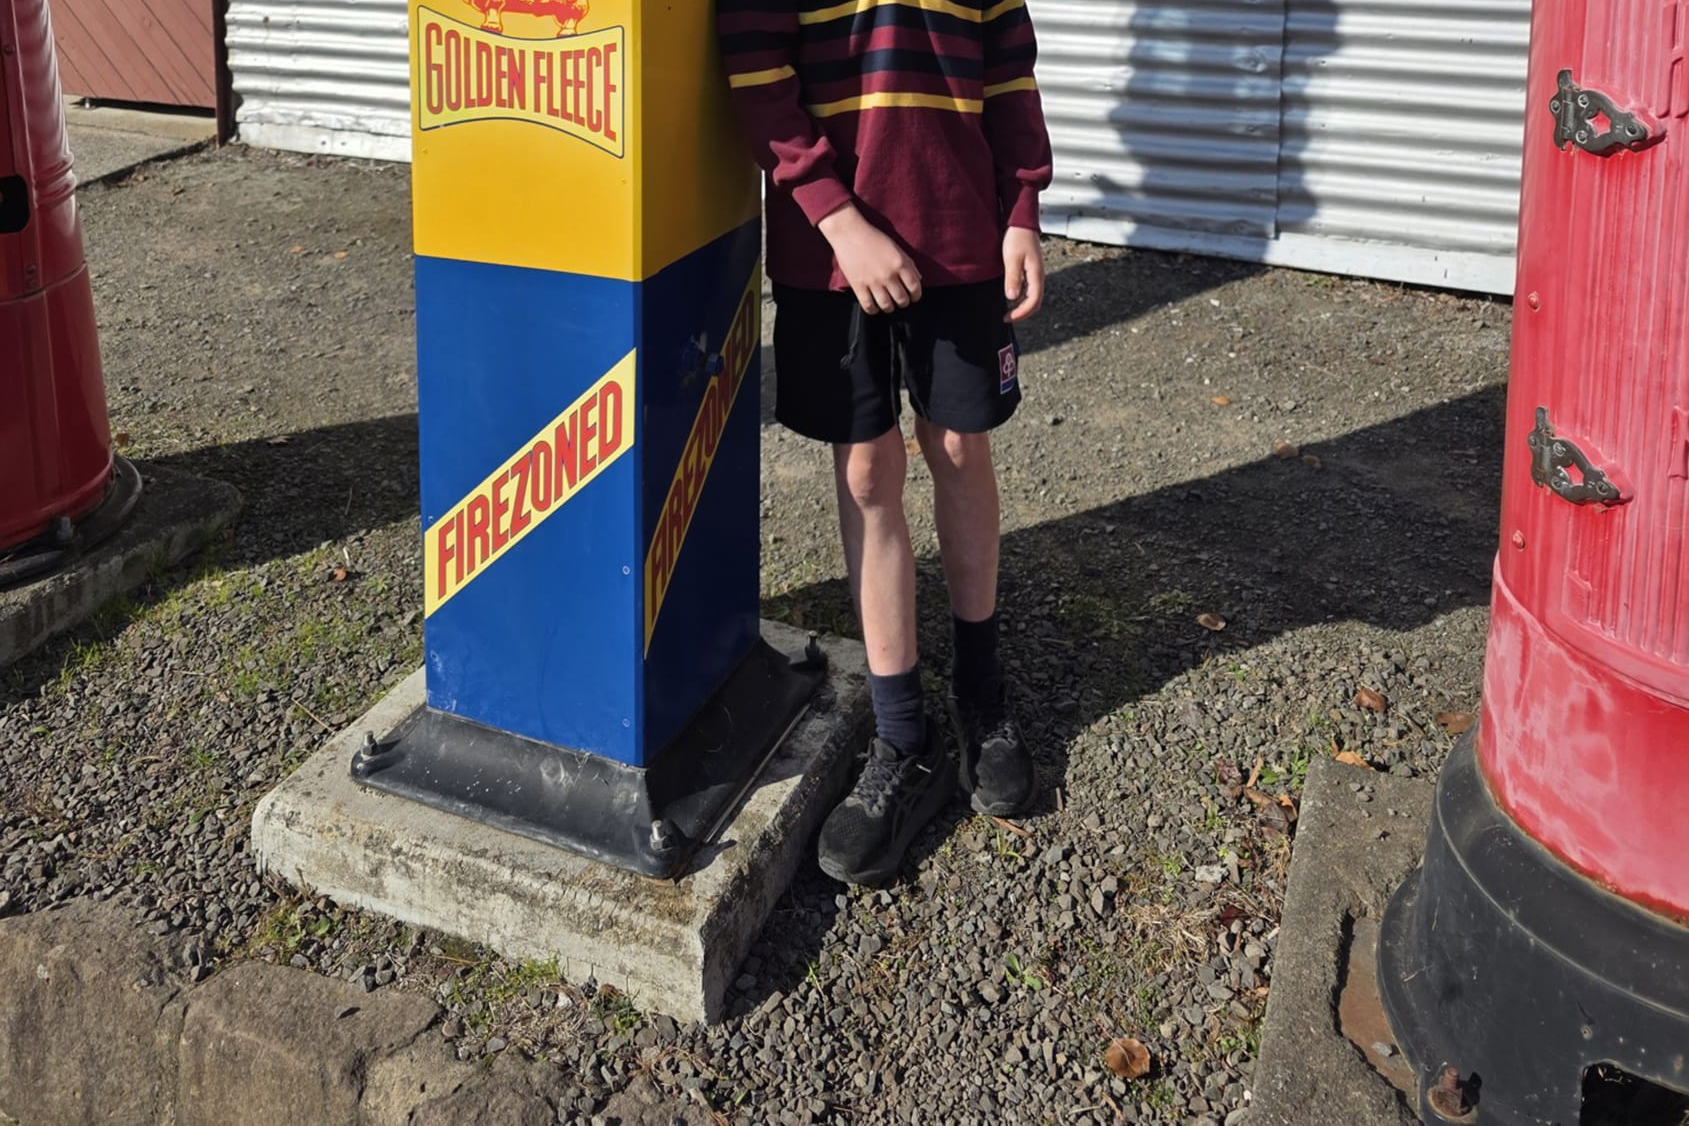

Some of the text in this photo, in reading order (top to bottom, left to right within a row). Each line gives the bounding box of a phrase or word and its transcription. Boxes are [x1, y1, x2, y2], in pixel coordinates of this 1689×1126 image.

[425, 22, 617, 143] GOLDEN FLEECE
[437, 380, 623, 601] FIREZONED
[651, 289, 755, 627] FIREZONED
